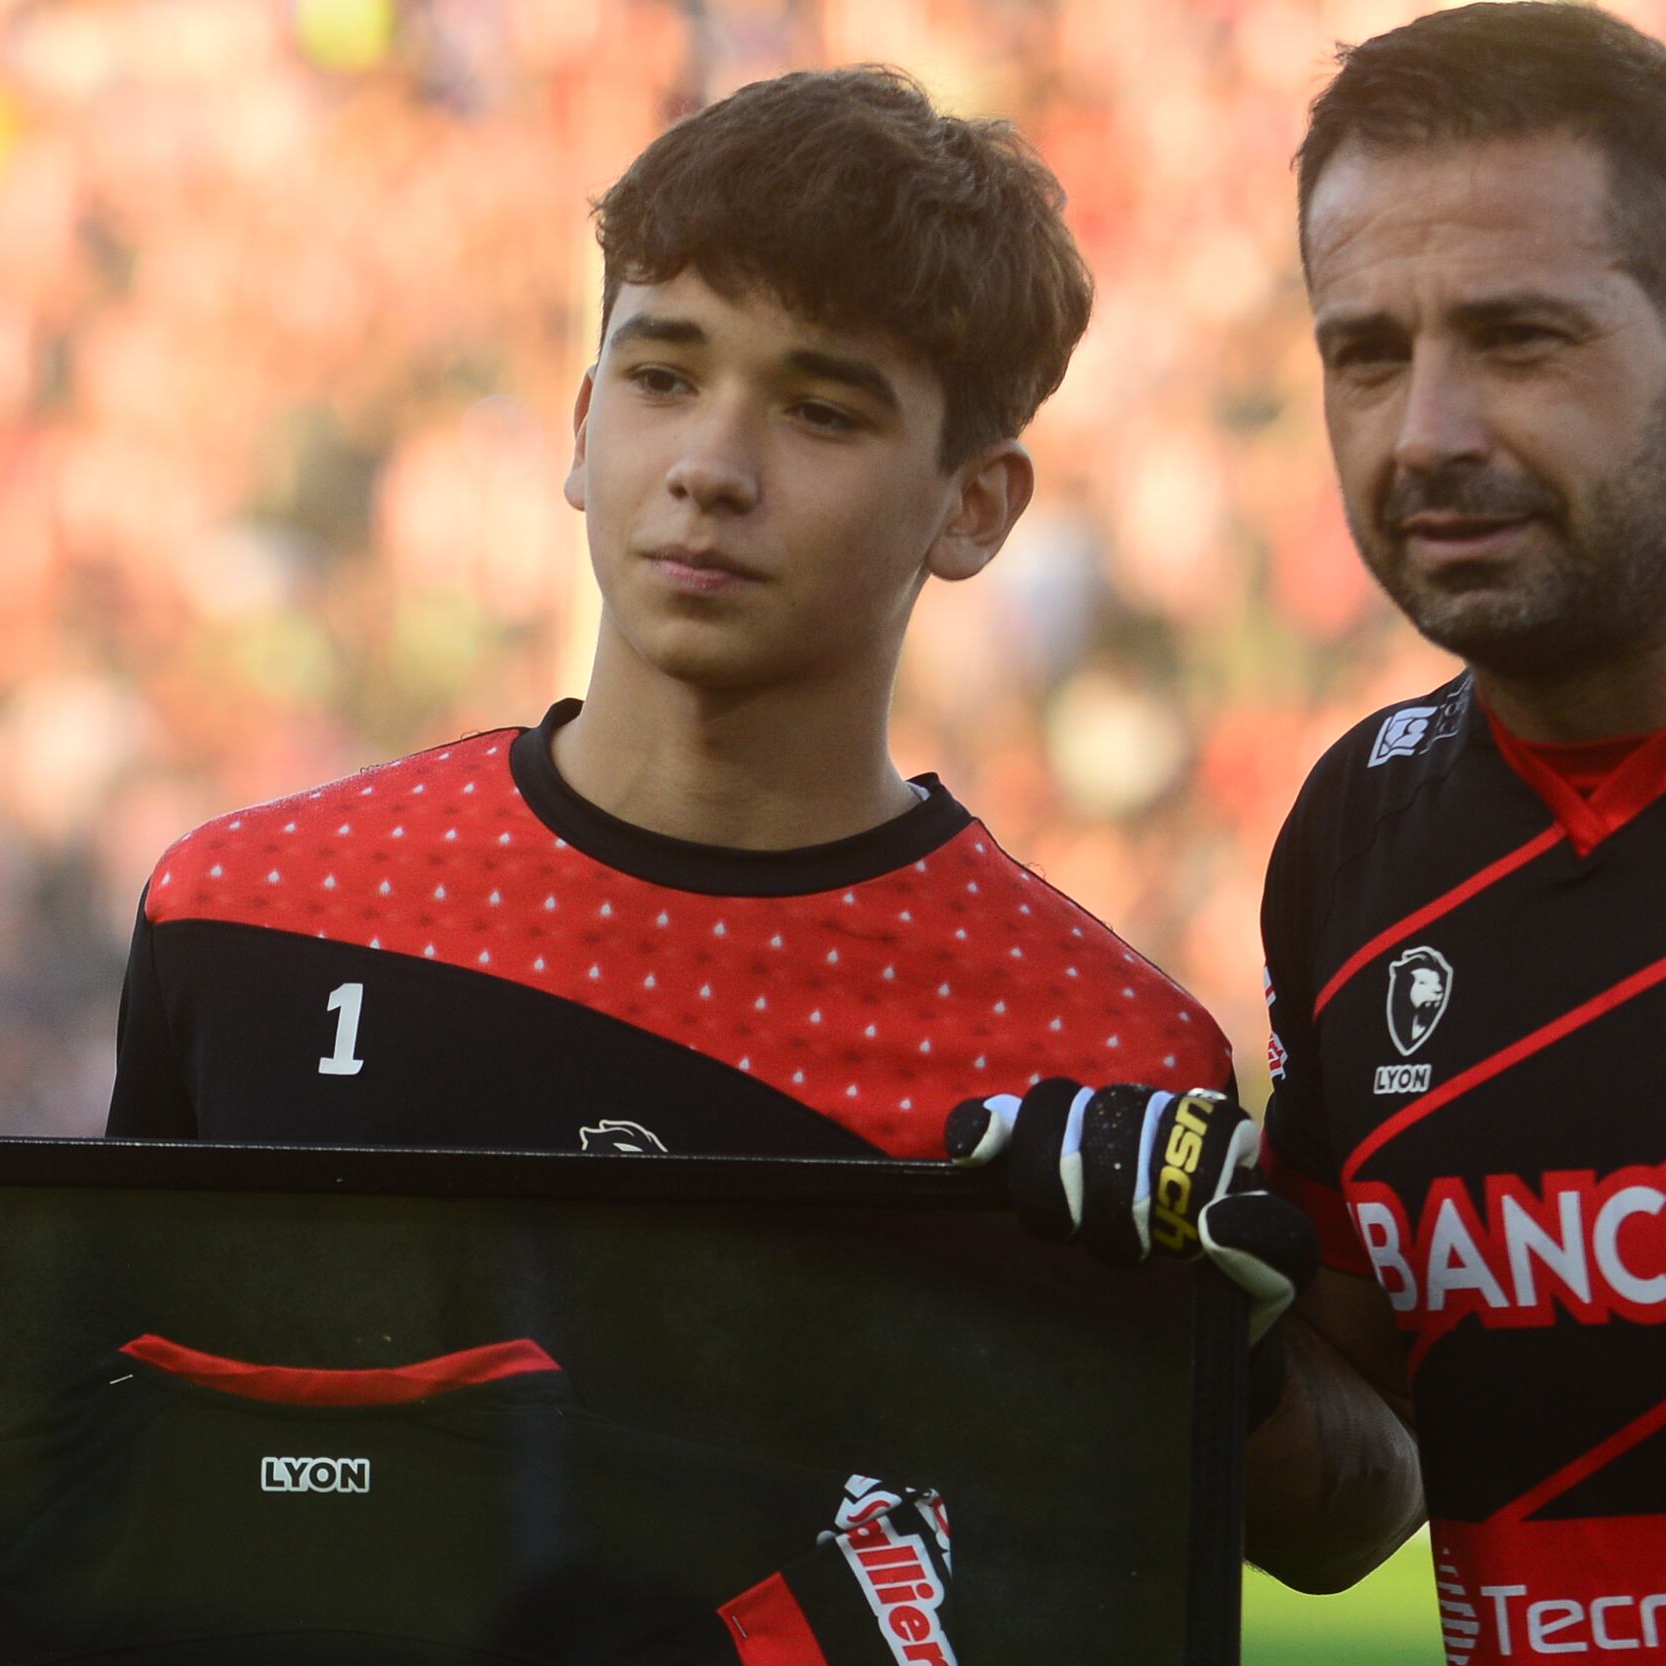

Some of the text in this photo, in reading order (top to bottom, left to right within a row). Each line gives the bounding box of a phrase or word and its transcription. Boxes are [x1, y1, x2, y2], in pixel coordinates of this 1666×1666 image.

[318, 982, 364, 1075] 1
[1374, 1064, 1432, 1094] LYON
[262, 1458, 369, 1492] LYON
